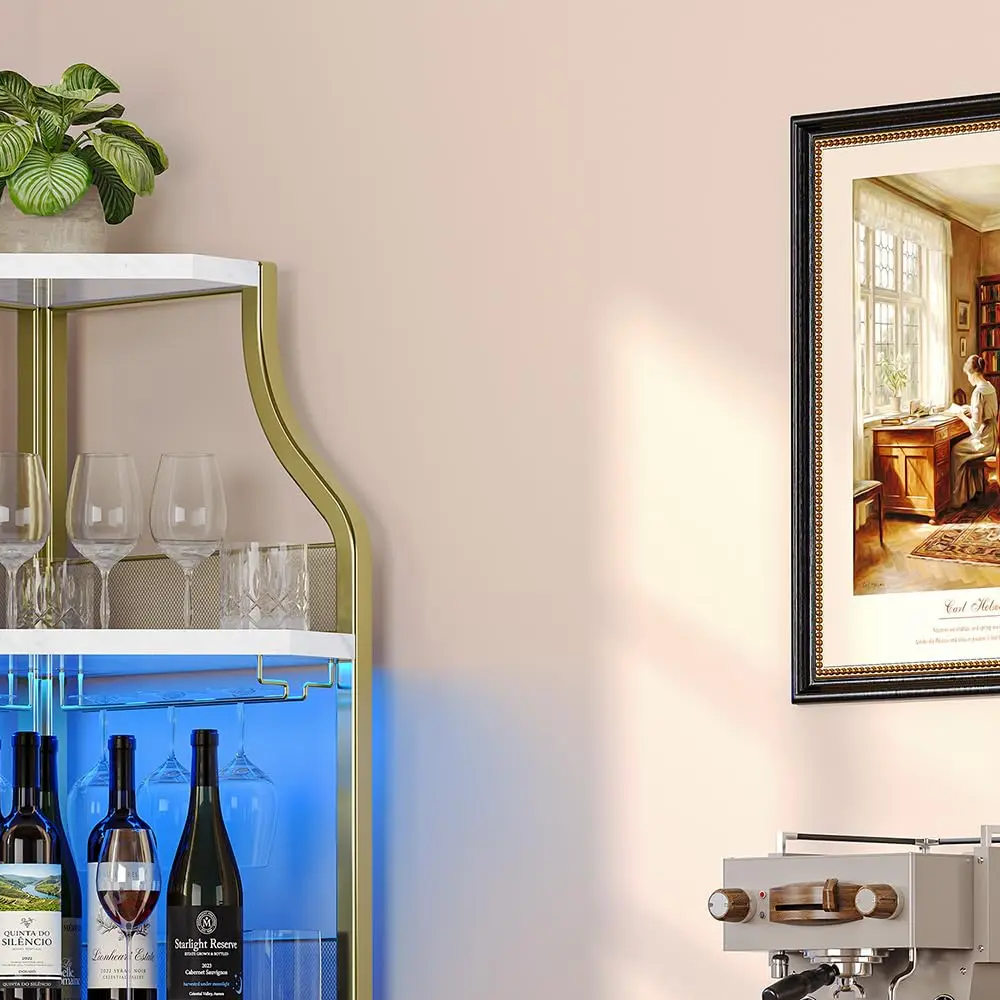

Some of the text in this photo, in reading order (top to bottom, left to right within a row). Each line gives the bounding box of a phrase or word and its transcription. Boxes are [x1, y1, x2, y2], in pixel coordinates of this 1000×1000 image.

[944, 600, 968, 614] Carl
[3, 930, 37, 938] QUINTA
[1, 936, 53, 946] SILÊNCIO
[174, 938, 238, 952] Starlight Reserve
